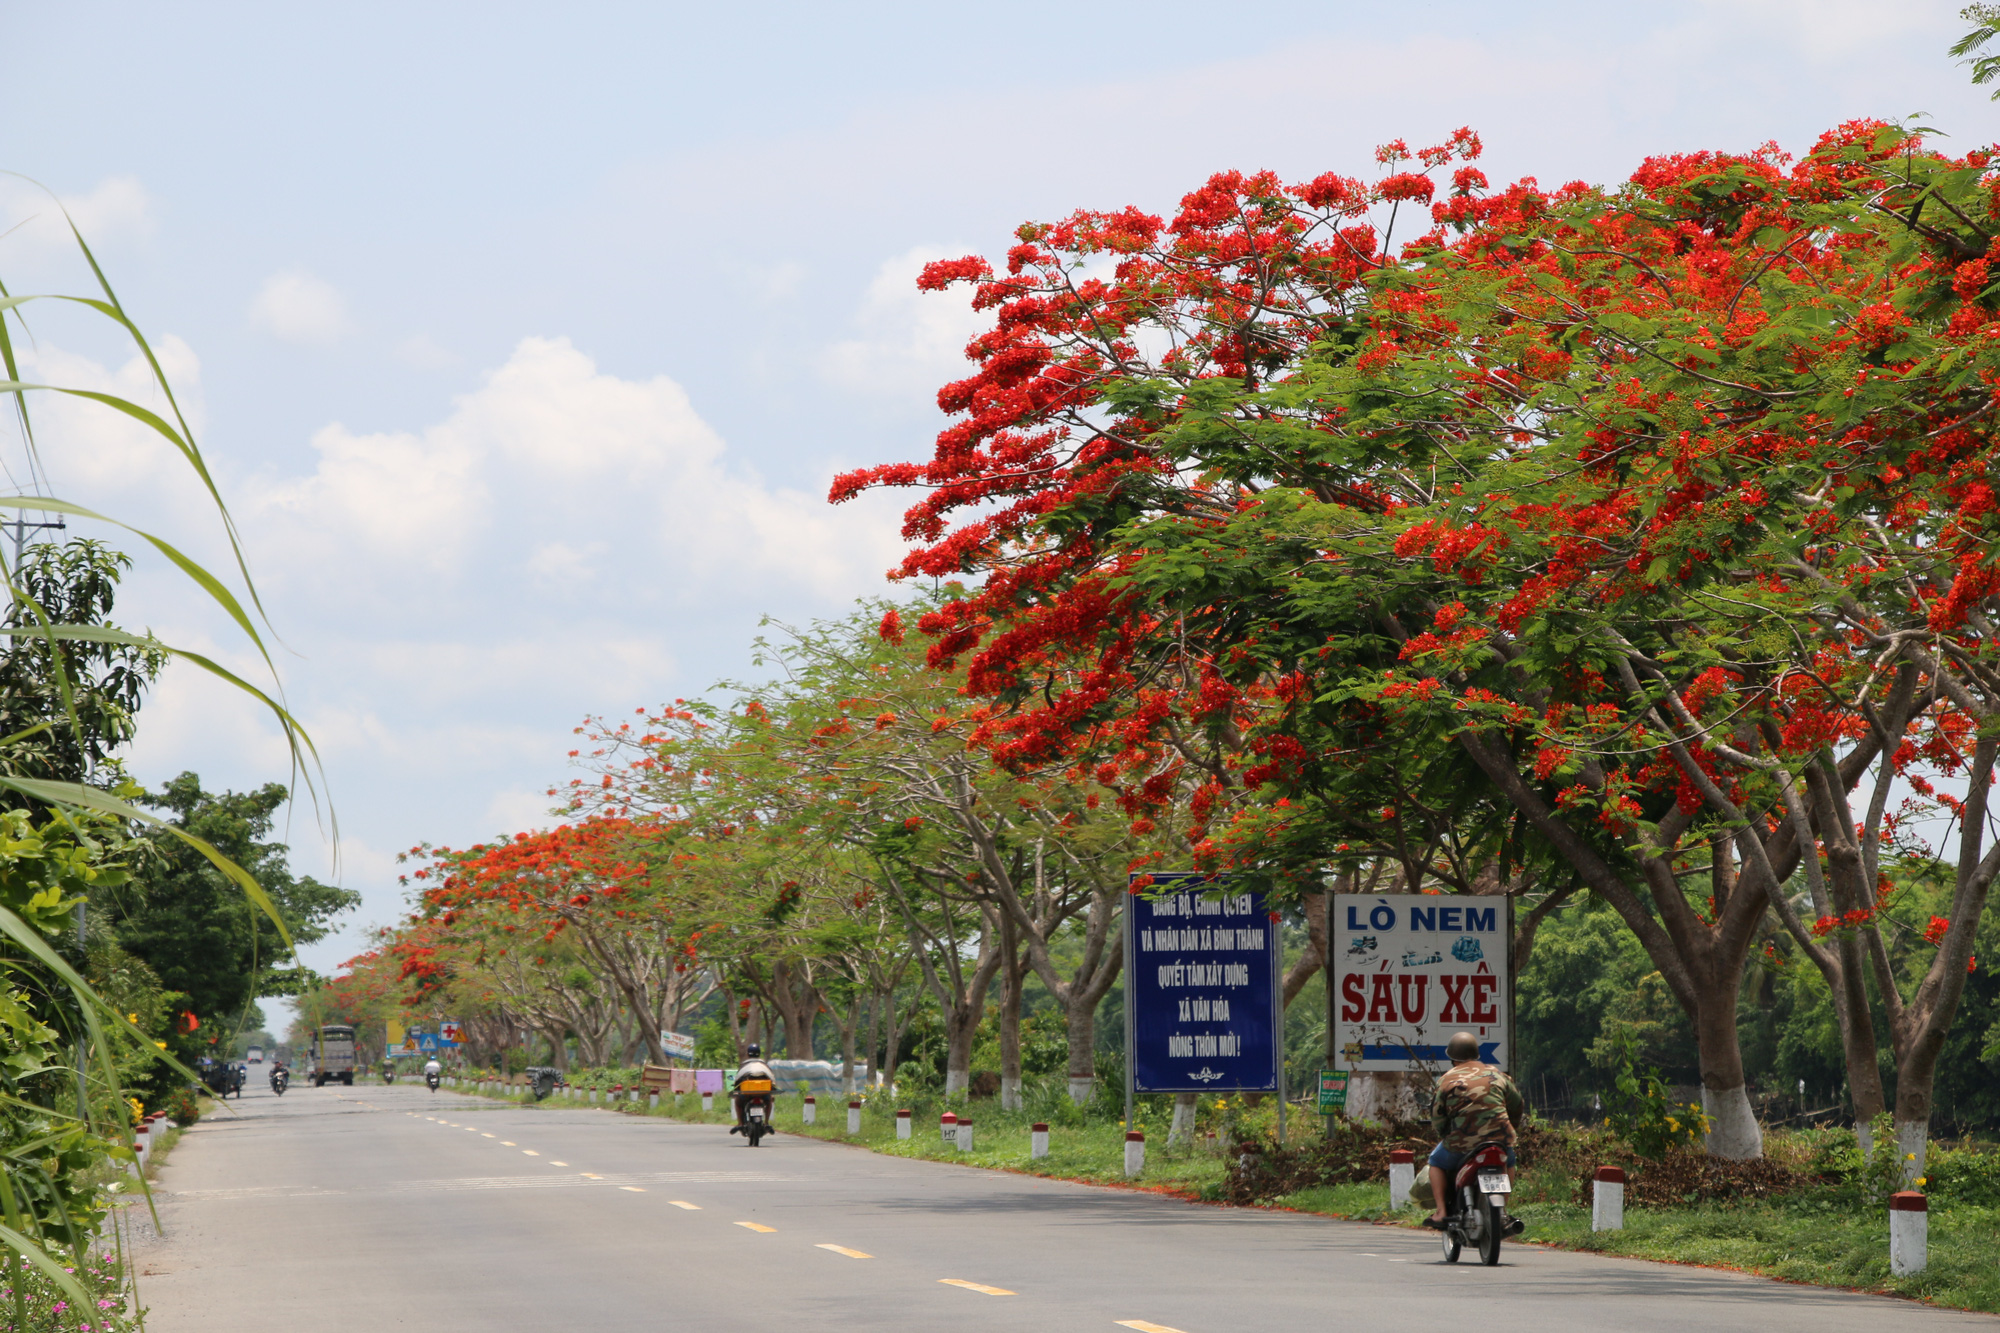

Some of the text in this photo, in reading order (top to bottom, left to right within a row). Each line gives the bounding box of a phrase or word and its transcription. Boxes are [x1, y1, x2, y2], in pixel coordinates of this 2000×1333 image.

[1347, 898, 1496, 932] LÒ NEM
[1141, 924, 1264, 952] VÀ NHÂN DÂN XÃ BÌNH THÀNH
[1158, 958, 1249, 990] QUYẾT TÂM XÂY DỰNG
[1178, 995, 1230, 1022] XÃ VĂN HÓA
[1342, 959, 1498, 1036] SÁU XỆ
[1168, 1031, 1193, 1058] NÔNG
[1194, 1030, 1217, 1057] THÔN
[944, 1129, 956, 1138] H7
